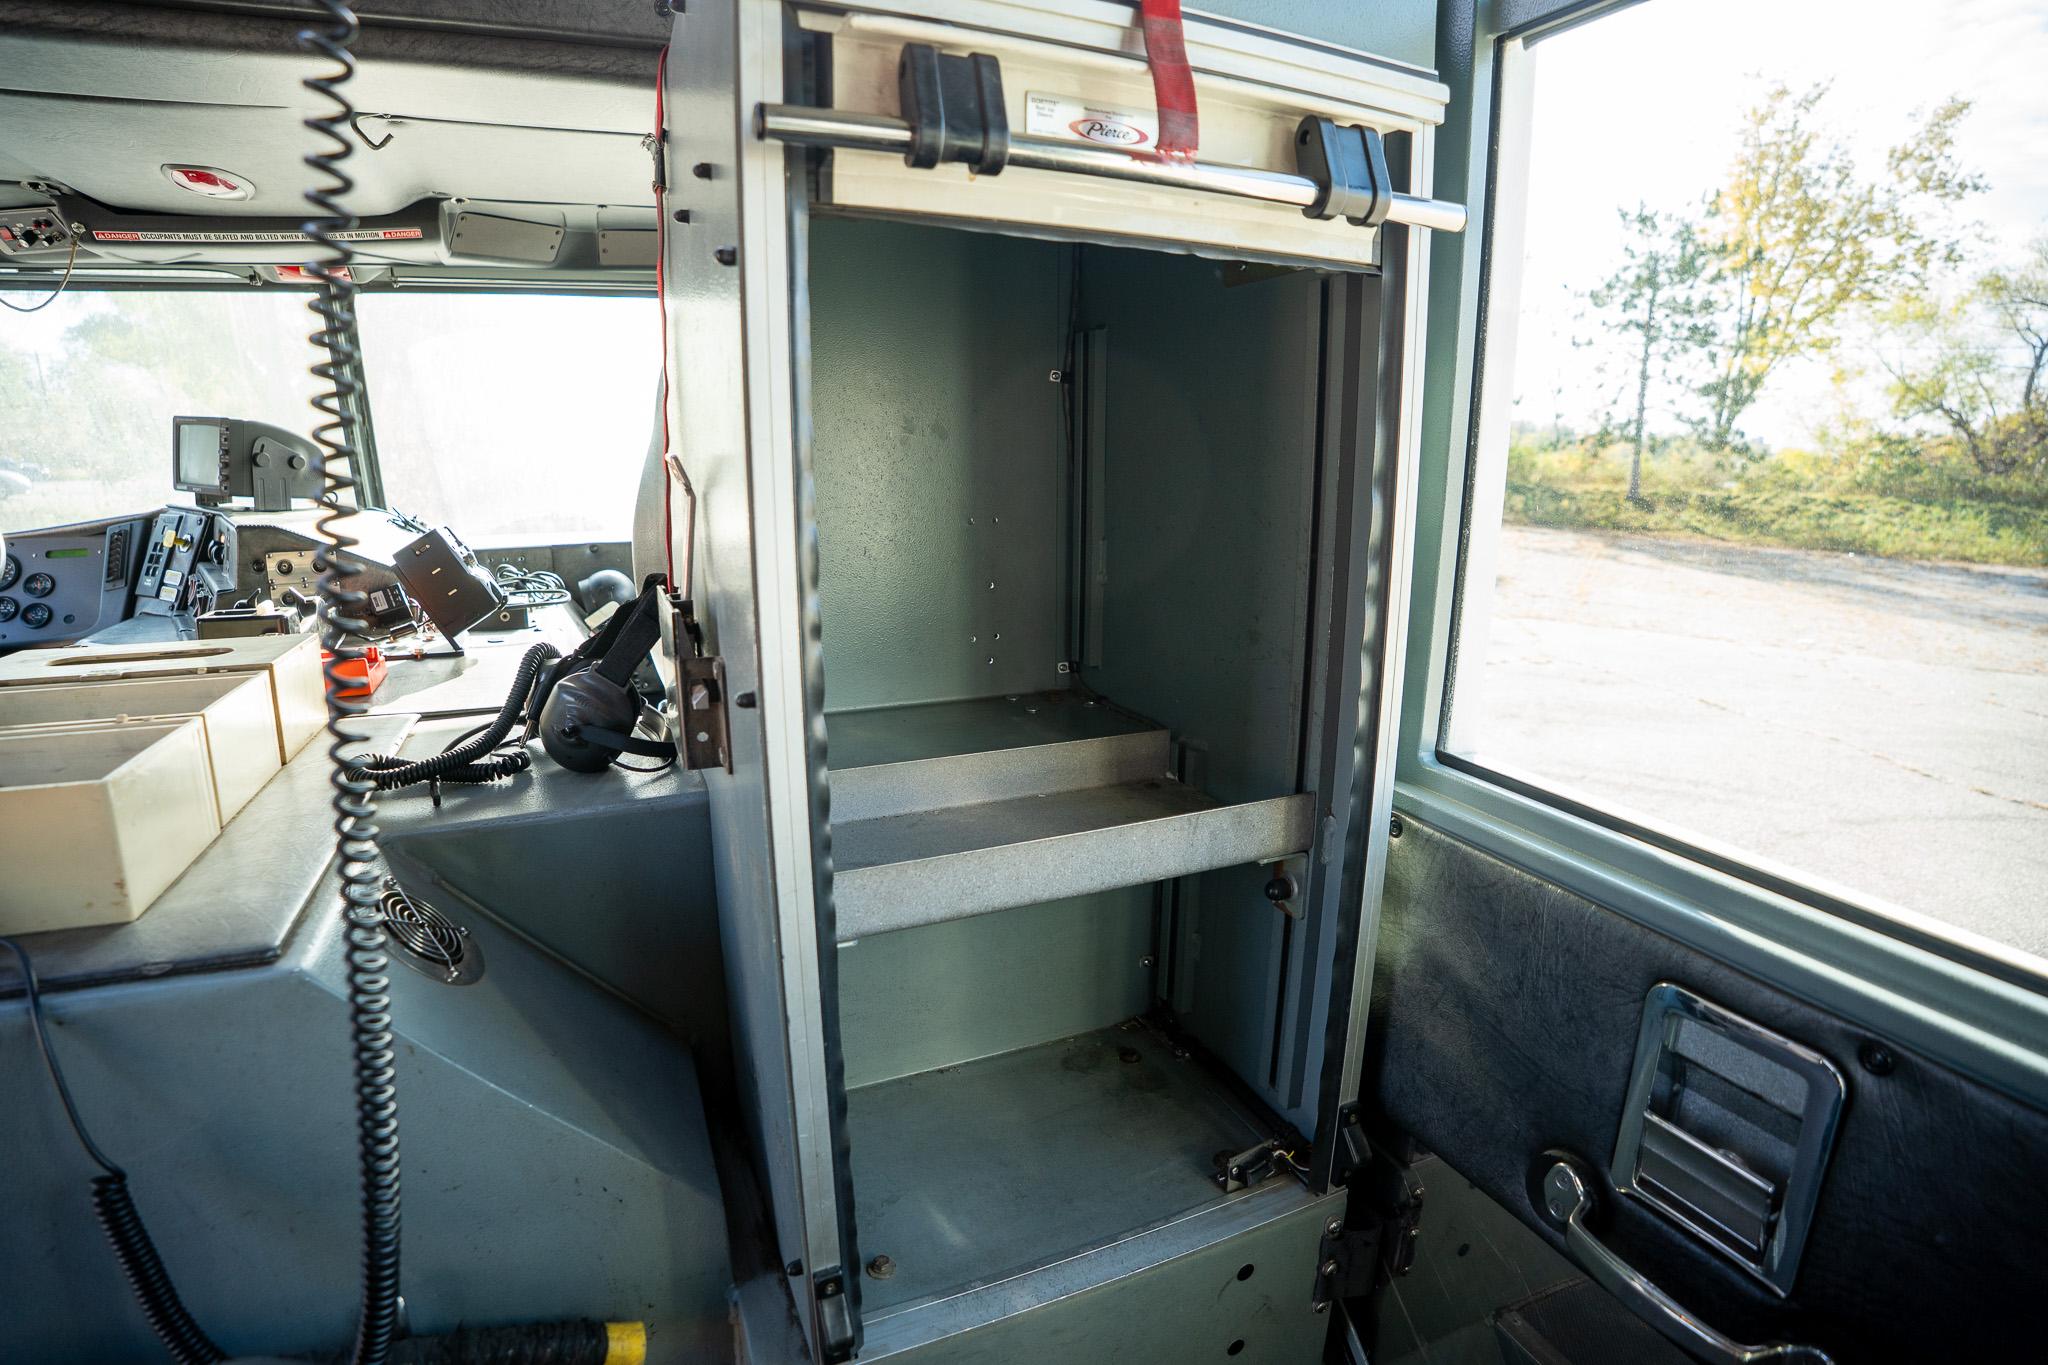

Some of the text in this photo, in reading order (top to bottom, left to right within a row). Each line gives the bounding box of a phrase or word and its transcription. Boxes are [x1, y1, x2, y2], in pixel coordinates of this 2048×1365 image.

[1087, 121, 1130, 140] Pierce
[105, 232, 139, 240] DANGER
[141, 232, 181, 240] OCCUPANTS
[391, 230, 421, 238] DANGER
